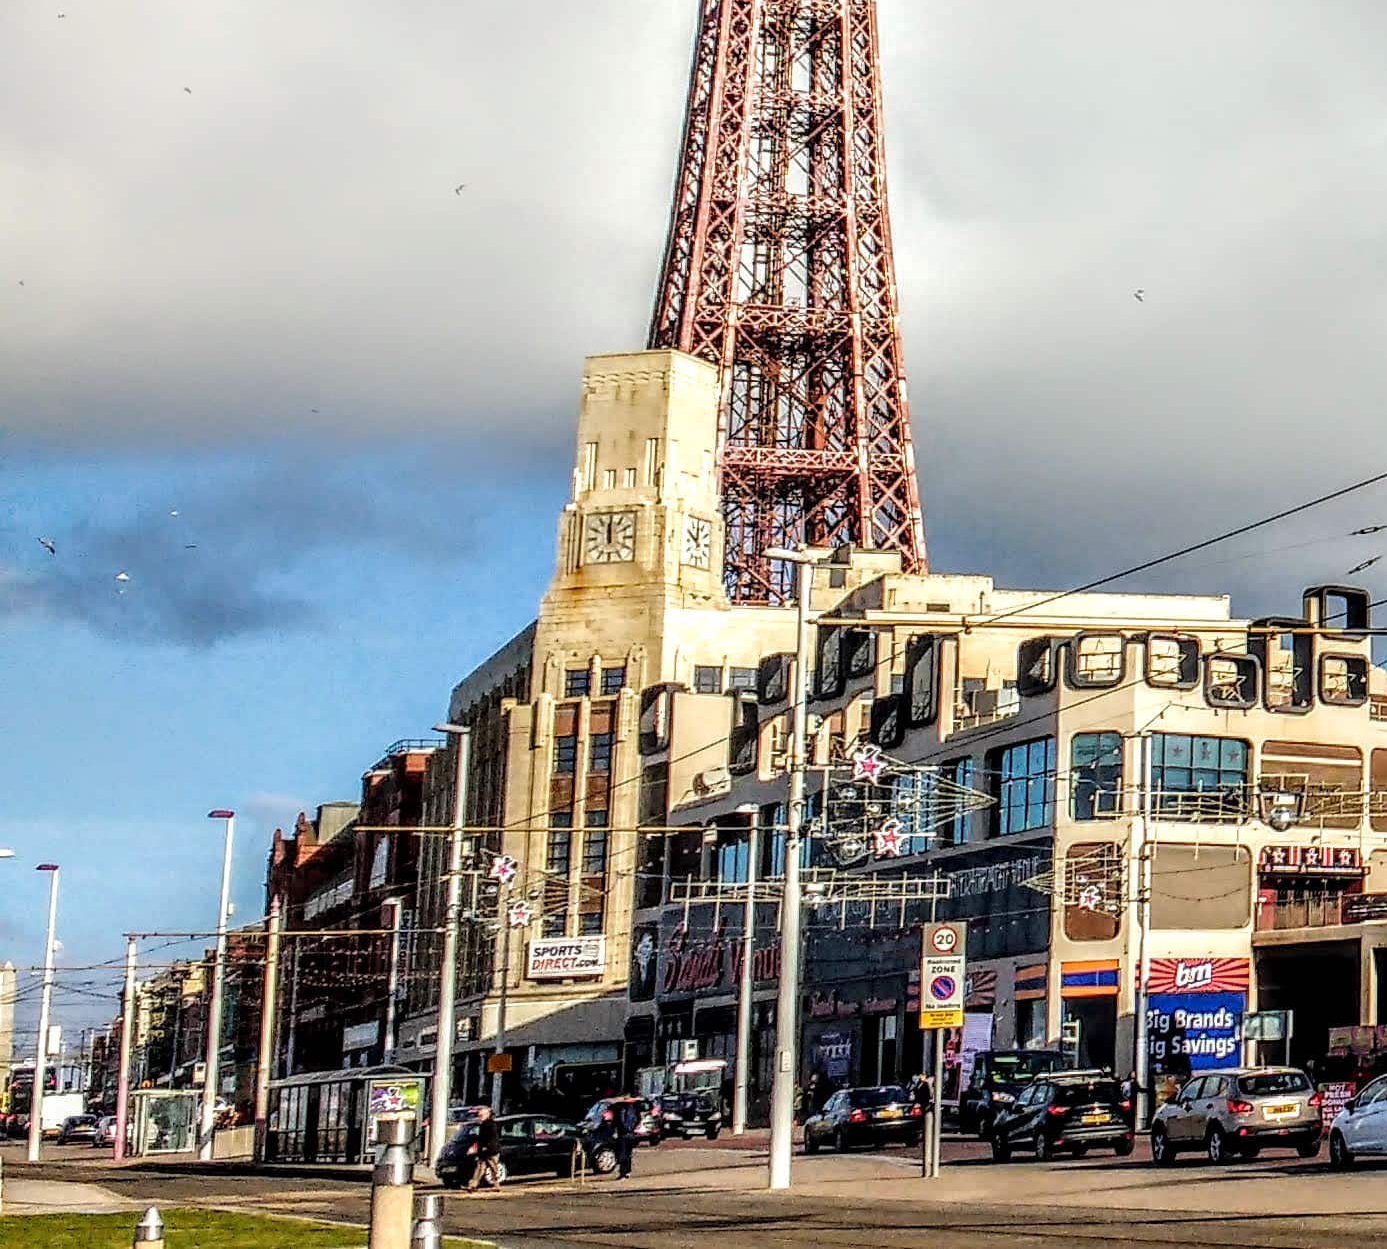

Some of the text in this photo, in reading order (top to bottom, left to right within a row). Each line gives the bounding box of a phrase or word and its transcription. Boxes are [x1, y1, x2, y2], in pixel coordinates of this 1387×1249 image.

[936, 934, 954, 945] 20
[532, 945, 583, 958] SPORTS
[931, 965, 956, 973] ZONE
[1174, 1007, 1234, 1030] Brands
[1149, 1033, 1236, 1060] ig Savings
